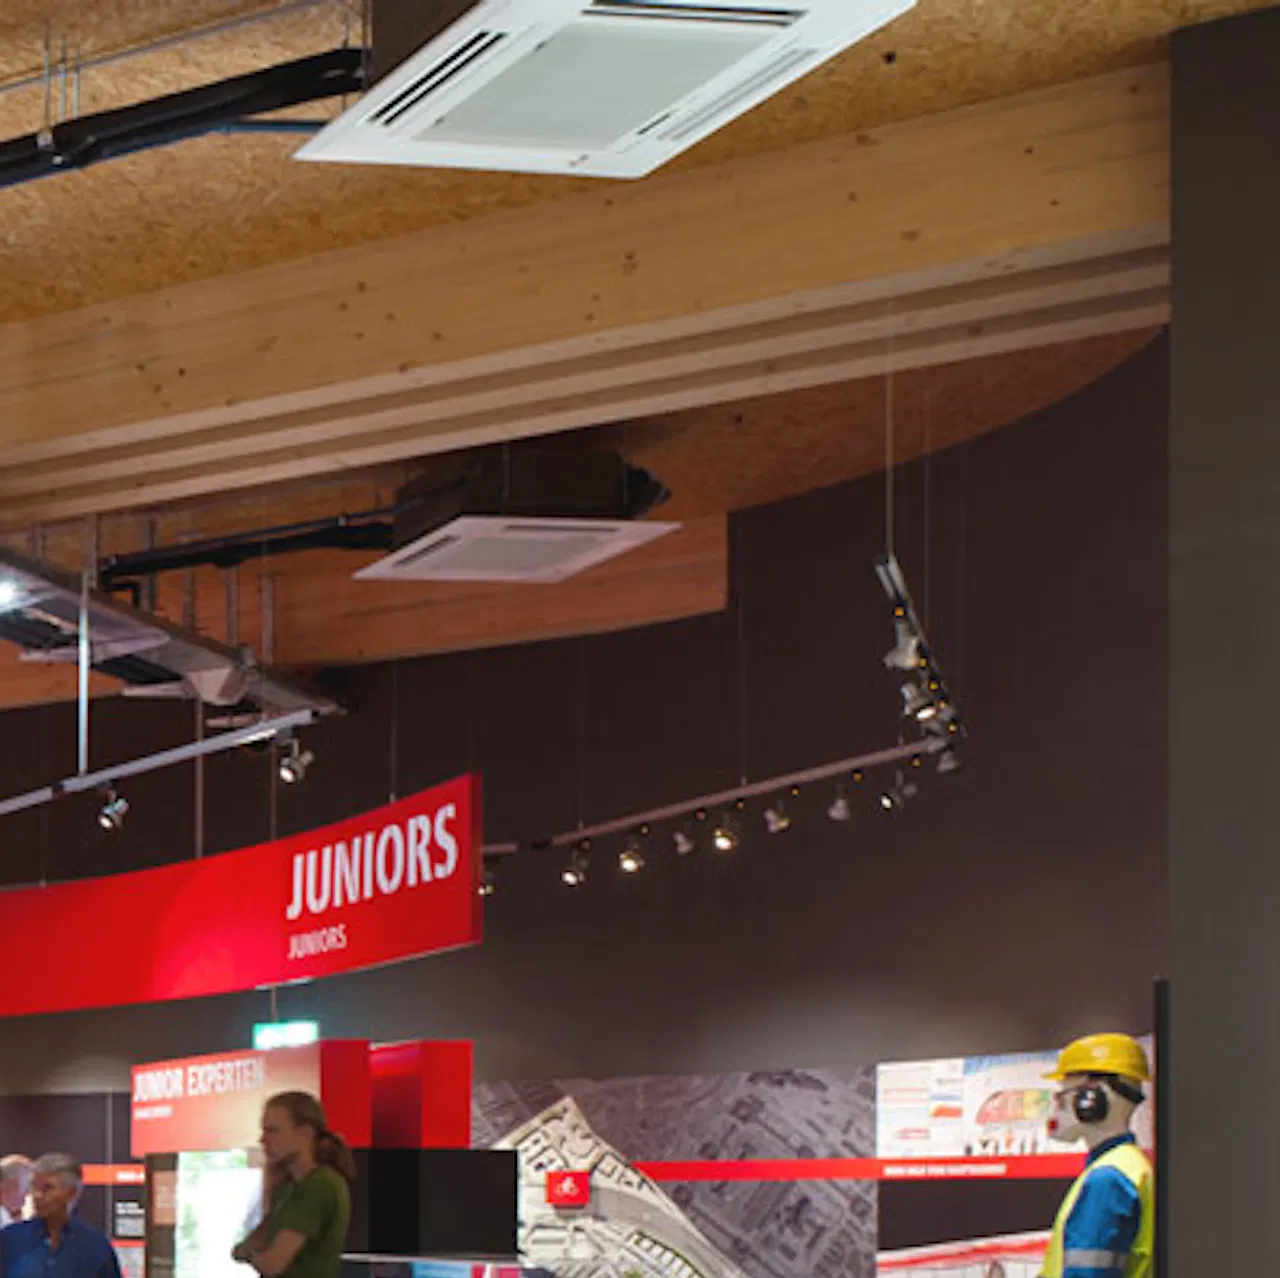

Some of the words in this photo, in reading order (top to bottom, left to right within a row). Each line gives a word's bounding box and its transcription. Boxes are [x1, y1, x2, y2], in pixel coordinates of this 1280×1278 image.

[286, 802, 459, 921] JUNIORS
[288, 923, 348, 960] JUNIORS
[133, 1067, 184, 1103] JUNIOR
